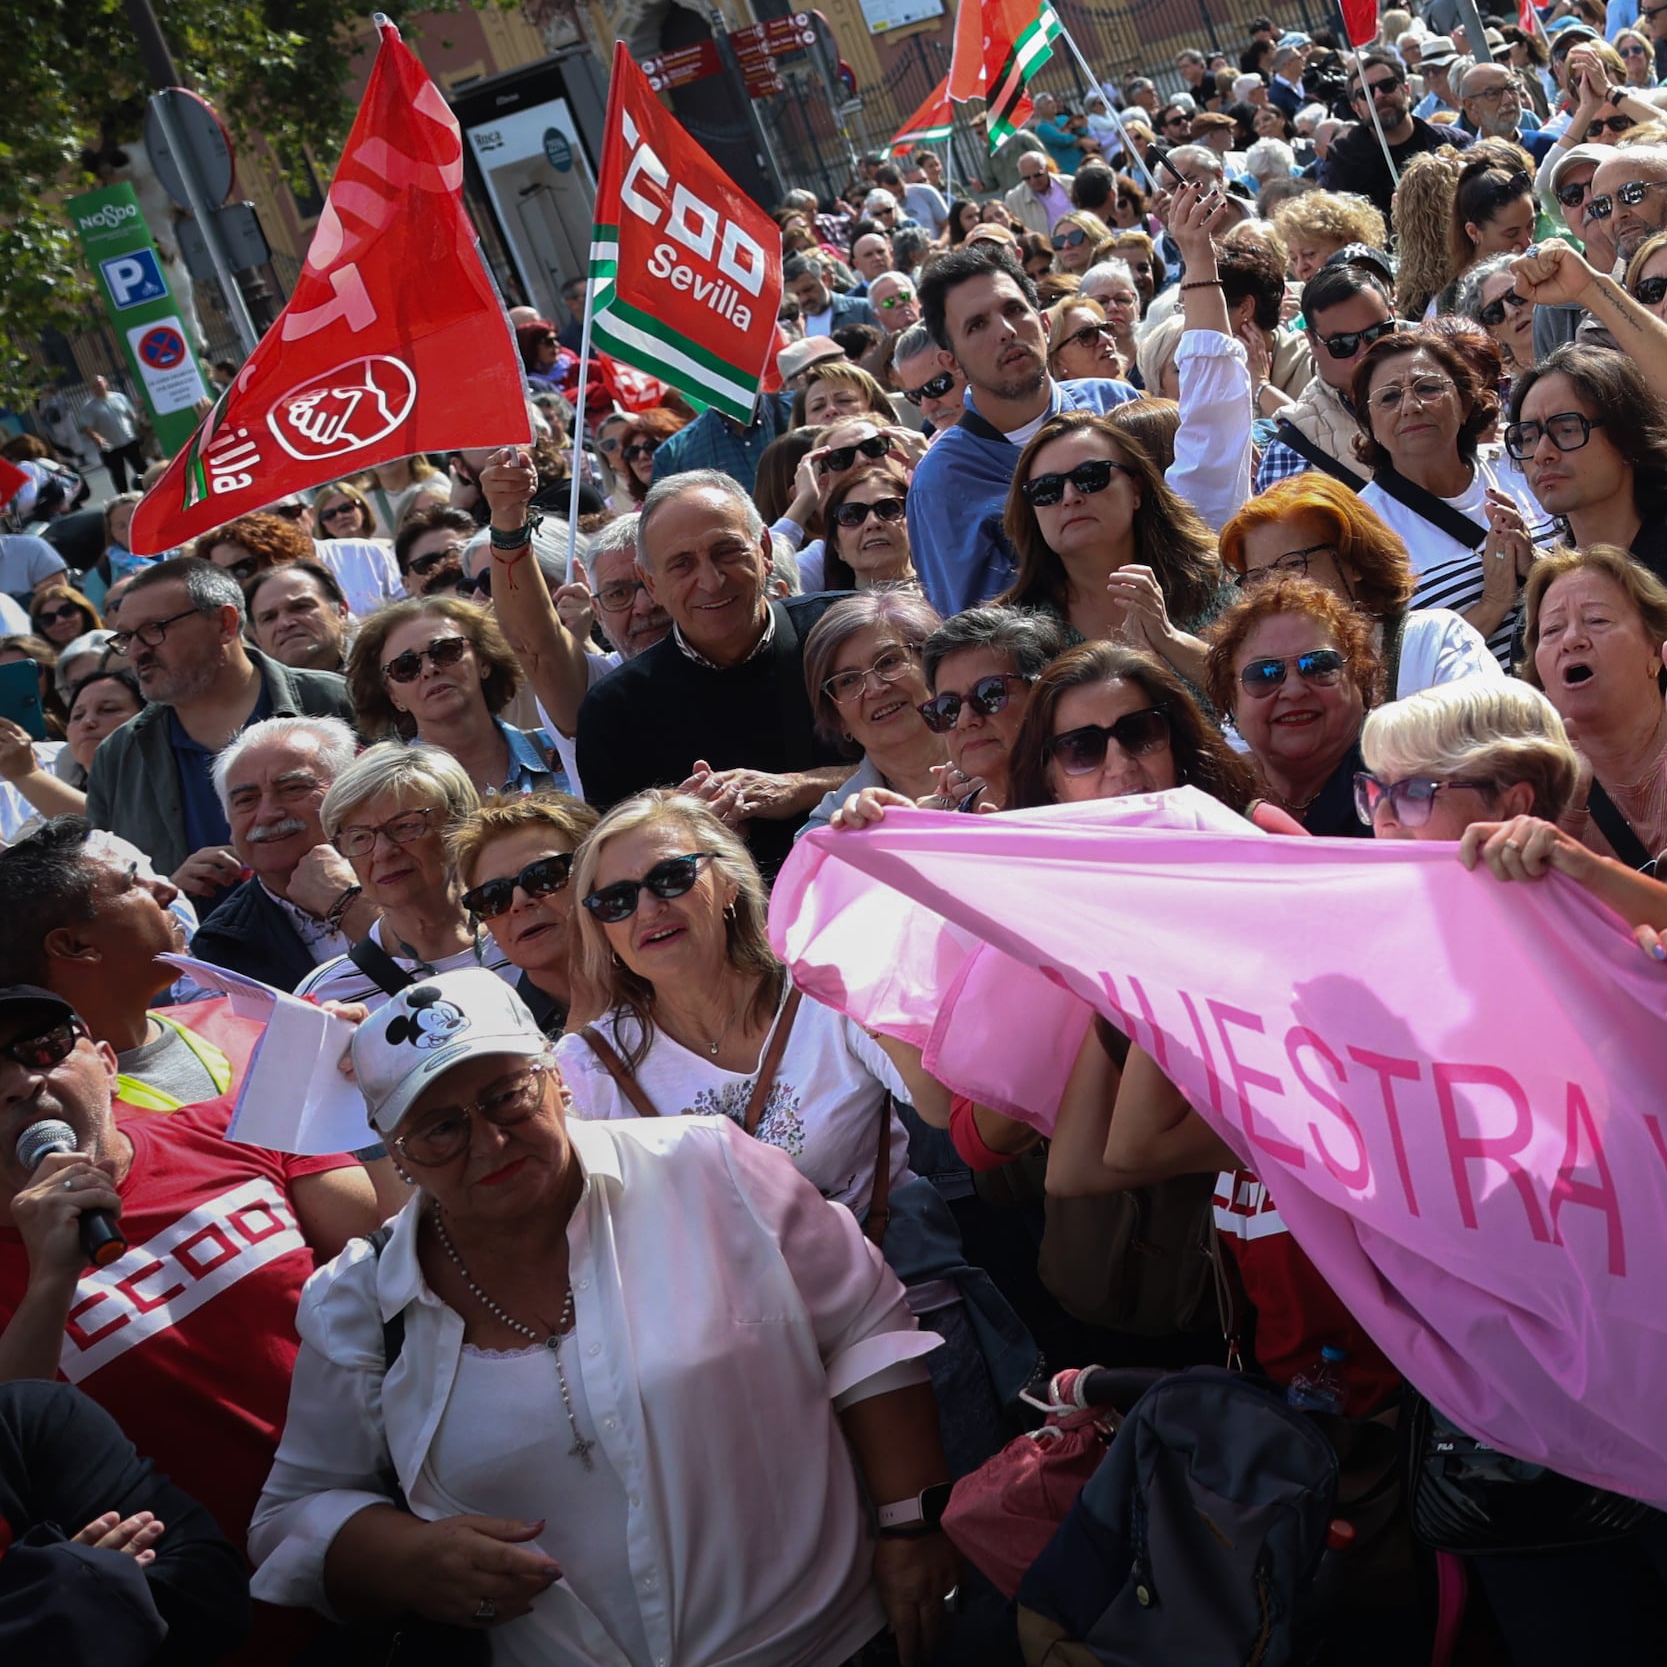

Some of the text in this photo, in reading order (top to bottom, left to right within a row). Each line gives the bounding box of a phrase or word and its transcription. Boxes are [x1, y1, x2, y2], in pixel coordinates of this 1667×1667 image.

[104, 257, 145, 303] P
[647, 243, 752, 333] Sevilla
[66, 1196, 288, 1354] CCOO
